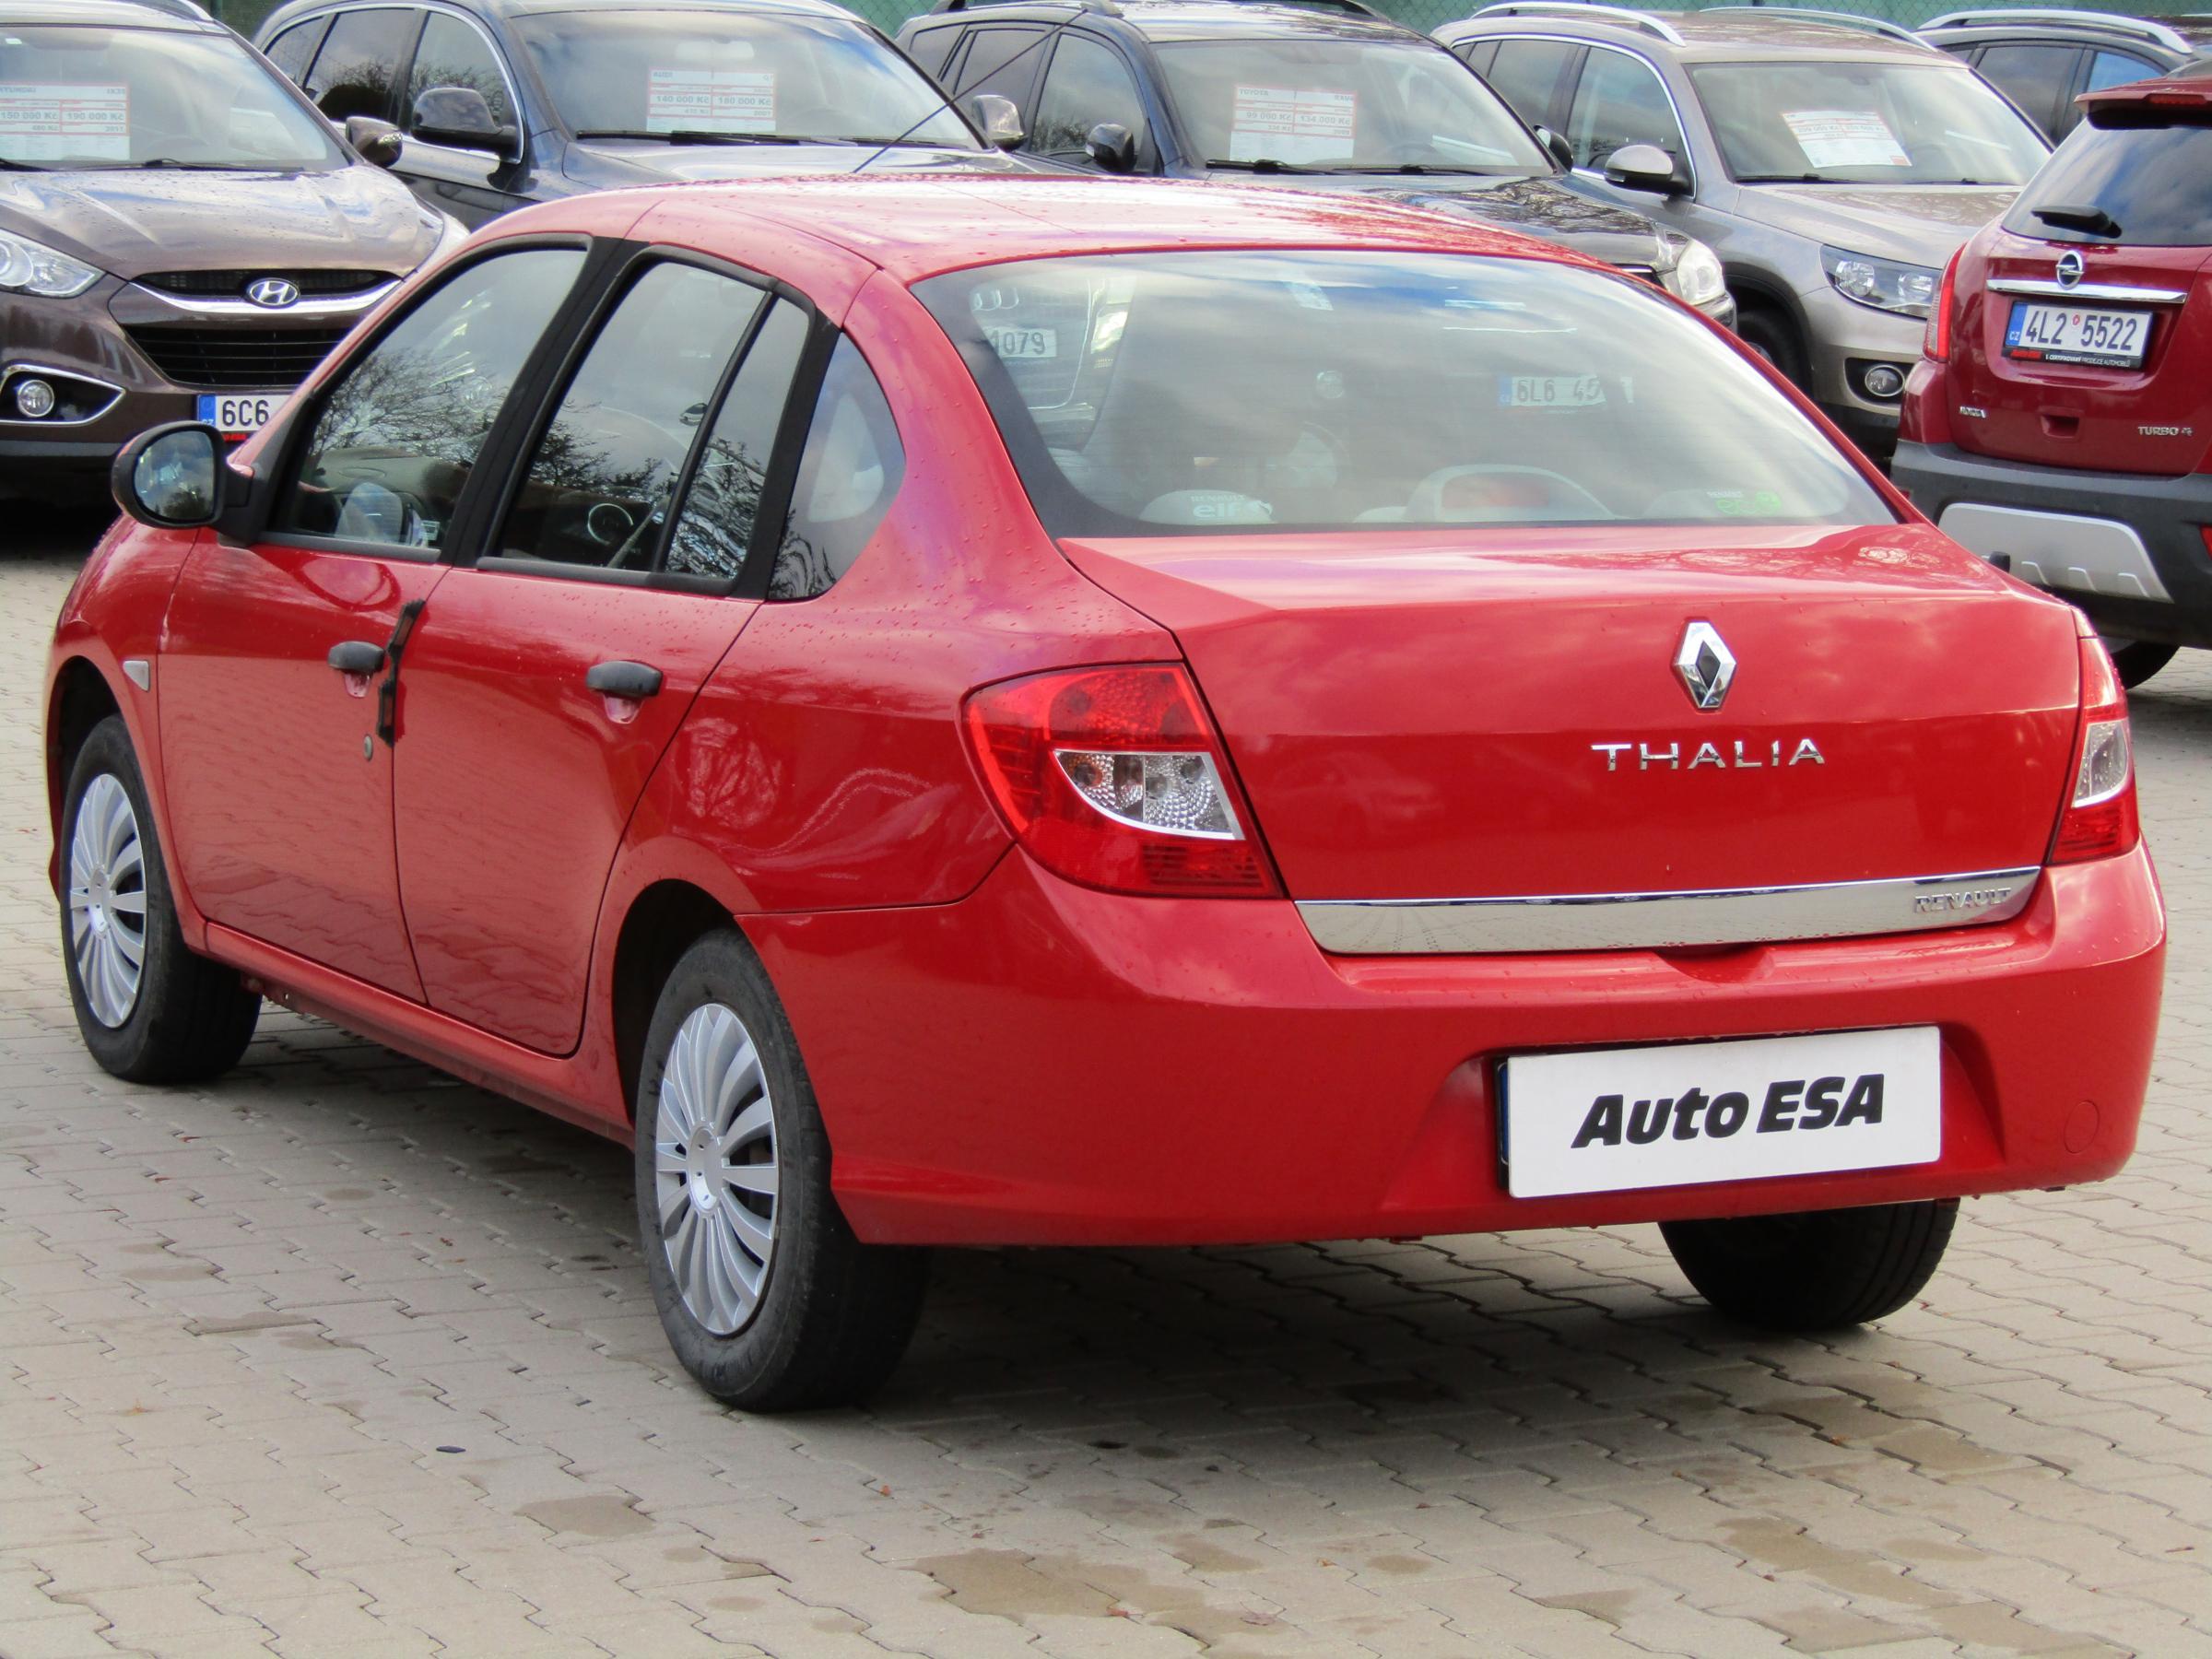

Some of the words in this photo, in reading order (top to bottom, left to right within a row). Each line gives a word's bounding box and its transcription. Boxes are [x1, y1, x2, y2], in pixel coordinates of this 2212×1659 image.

[656, 95, 674, 103] 140
[677, 95, 694, 104] 000
[719, 96, 735, 104] 180
[738, 97, 756, 105] 000
[2, 112, 20, 120] 150
[22, 112, 41, 120] 000
[66, 112, 87, 121] 190
[88, 112, 108, 121] 000
[1260, 112, 1277, 120] 000
[1319, 116, 1336, 124] 000
[2009, 330, 2021, 341] CZ
[2025, 310, 2067, 346] 4L2
[2080, 314, 2137, 351] 5522
[1517, 378, 1556, 403] 6L6
[221, 399, 269, 427] 6C6
[2138, 426, 2179, 436] TURBO
[1193, 501, 1241, 517] elf
[1591, 737, 1826, 771] THALIA
[1914, 887, 2012, 913] RENAULT
[1570, 1087, 1750, 1149] Auto
[1756, 1073, 1886, 1134] ESA
